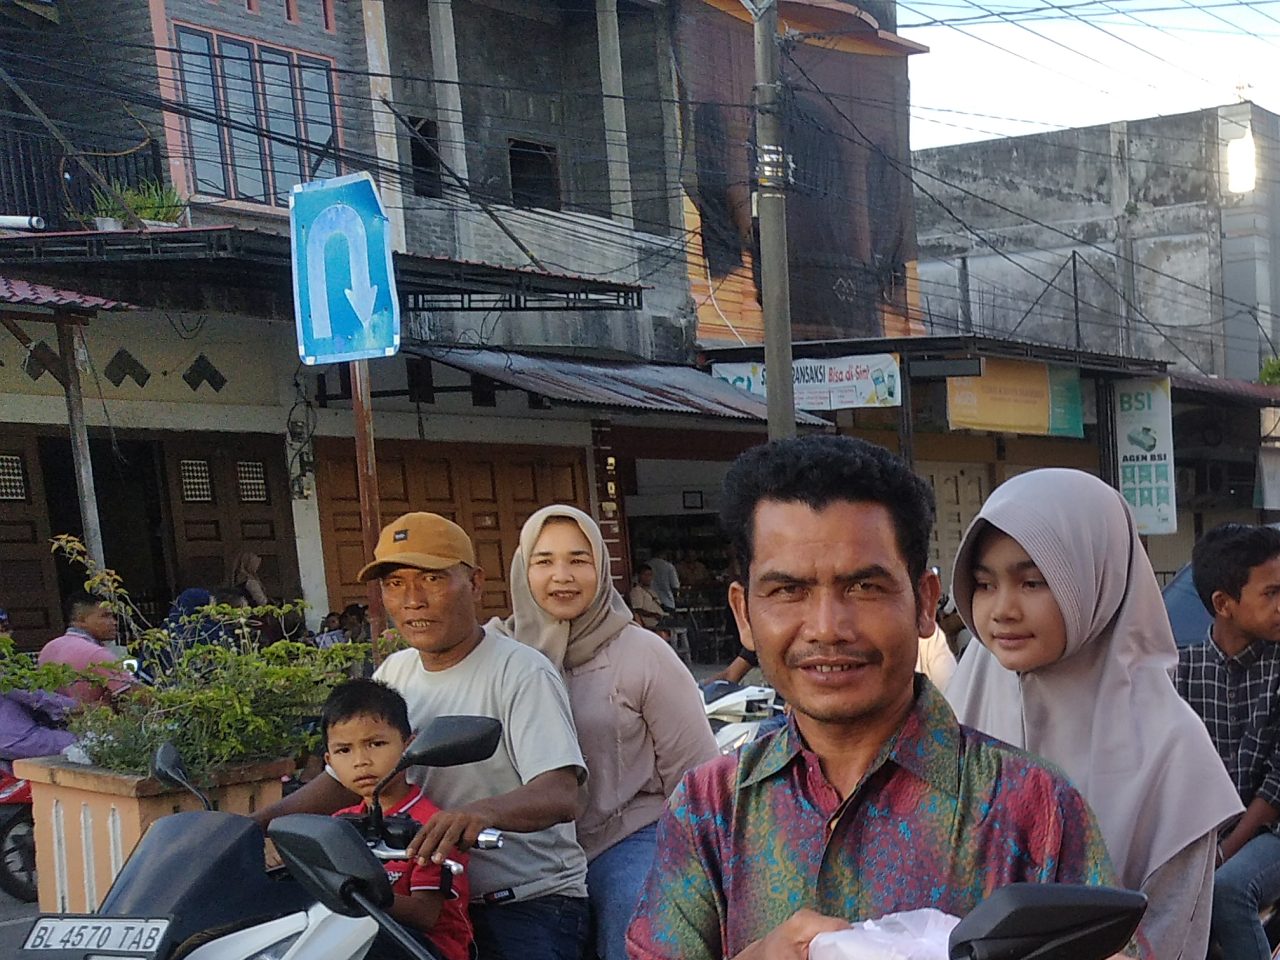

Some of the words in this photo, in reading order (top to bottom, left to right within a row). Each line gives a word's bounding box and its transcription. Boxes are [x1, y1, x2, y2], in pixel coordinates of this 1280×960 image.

[792, 364, 826, 384] RANSAKSI
[1120, 391, 1152, 411] BSI
[1122, 454, 1148, 463] AGEN
[1150, 453, 1167, 462] BSI
[31, 926, 55, 949] BL
[60, 926, 112, 949] 4570
[119, 926, 160, 950] TAB
